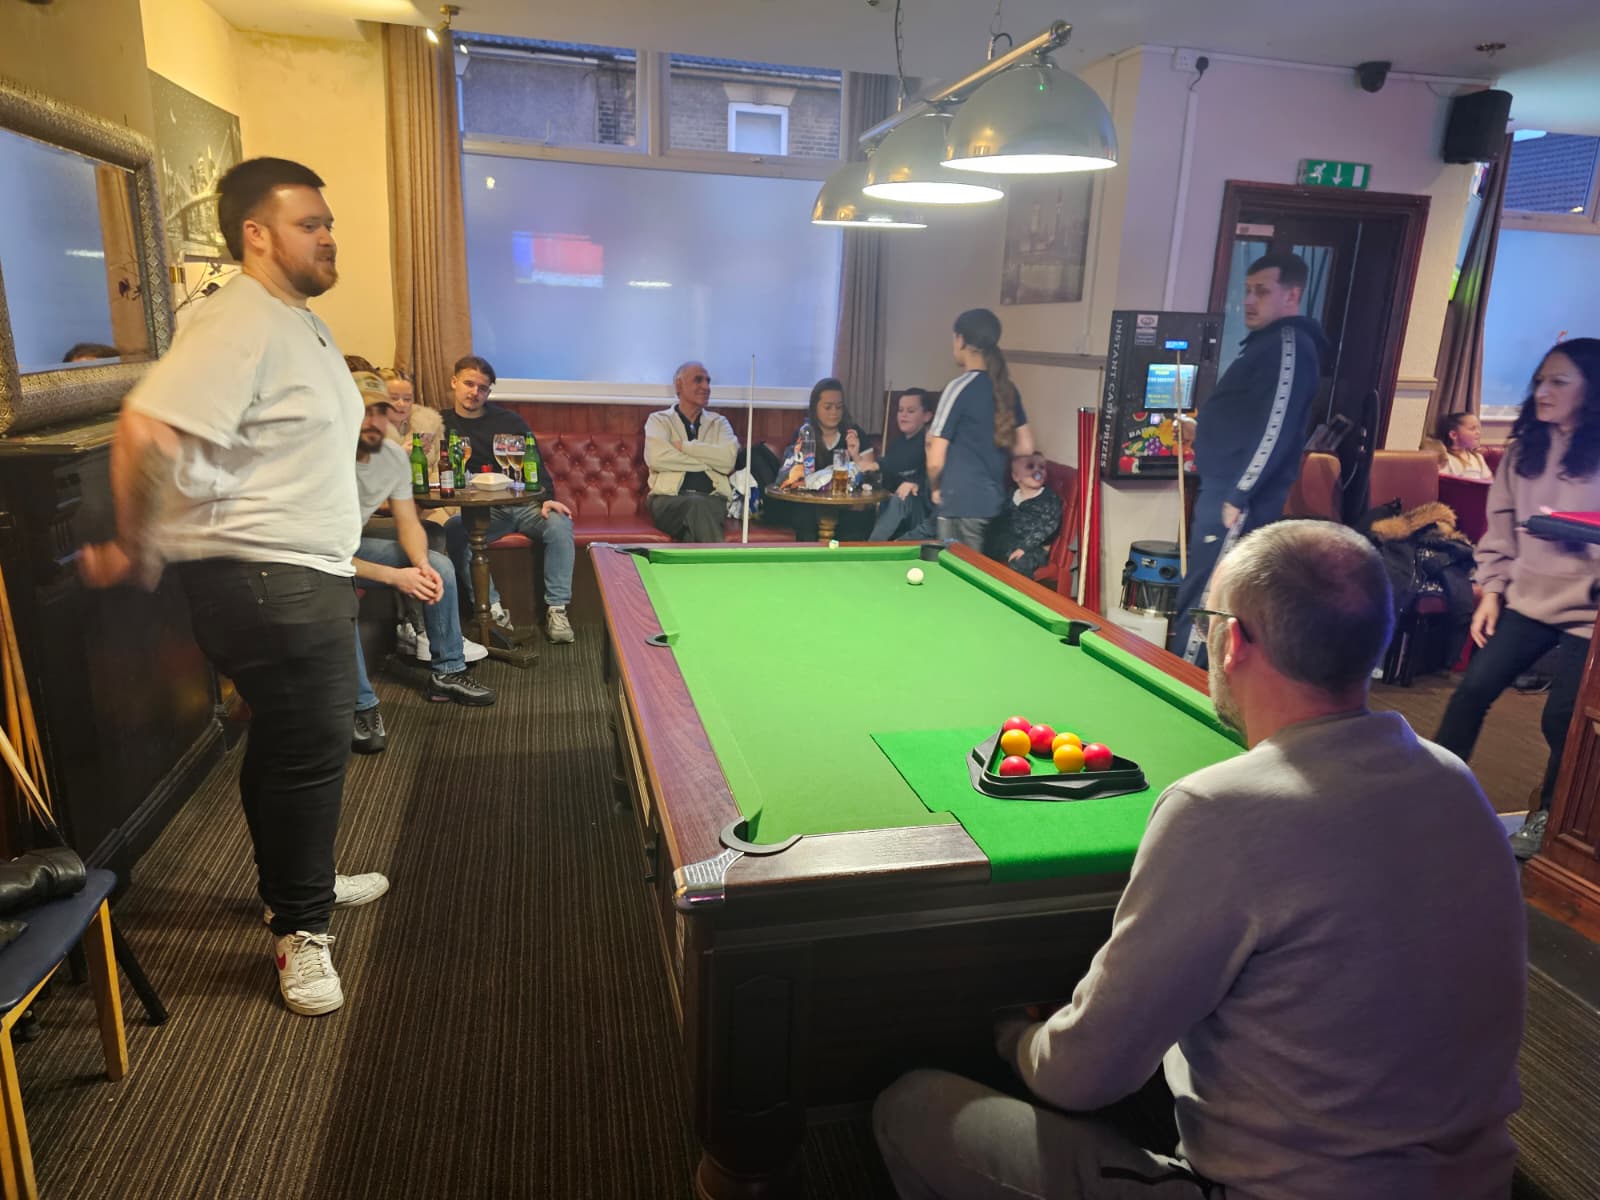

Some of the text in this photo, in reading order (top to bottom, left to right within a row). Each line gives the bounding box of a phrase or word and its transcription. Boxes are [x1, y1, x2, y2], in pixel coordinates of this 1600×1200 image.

[1100, 319, 1123, 468] INSTANT CASH PRIZES
